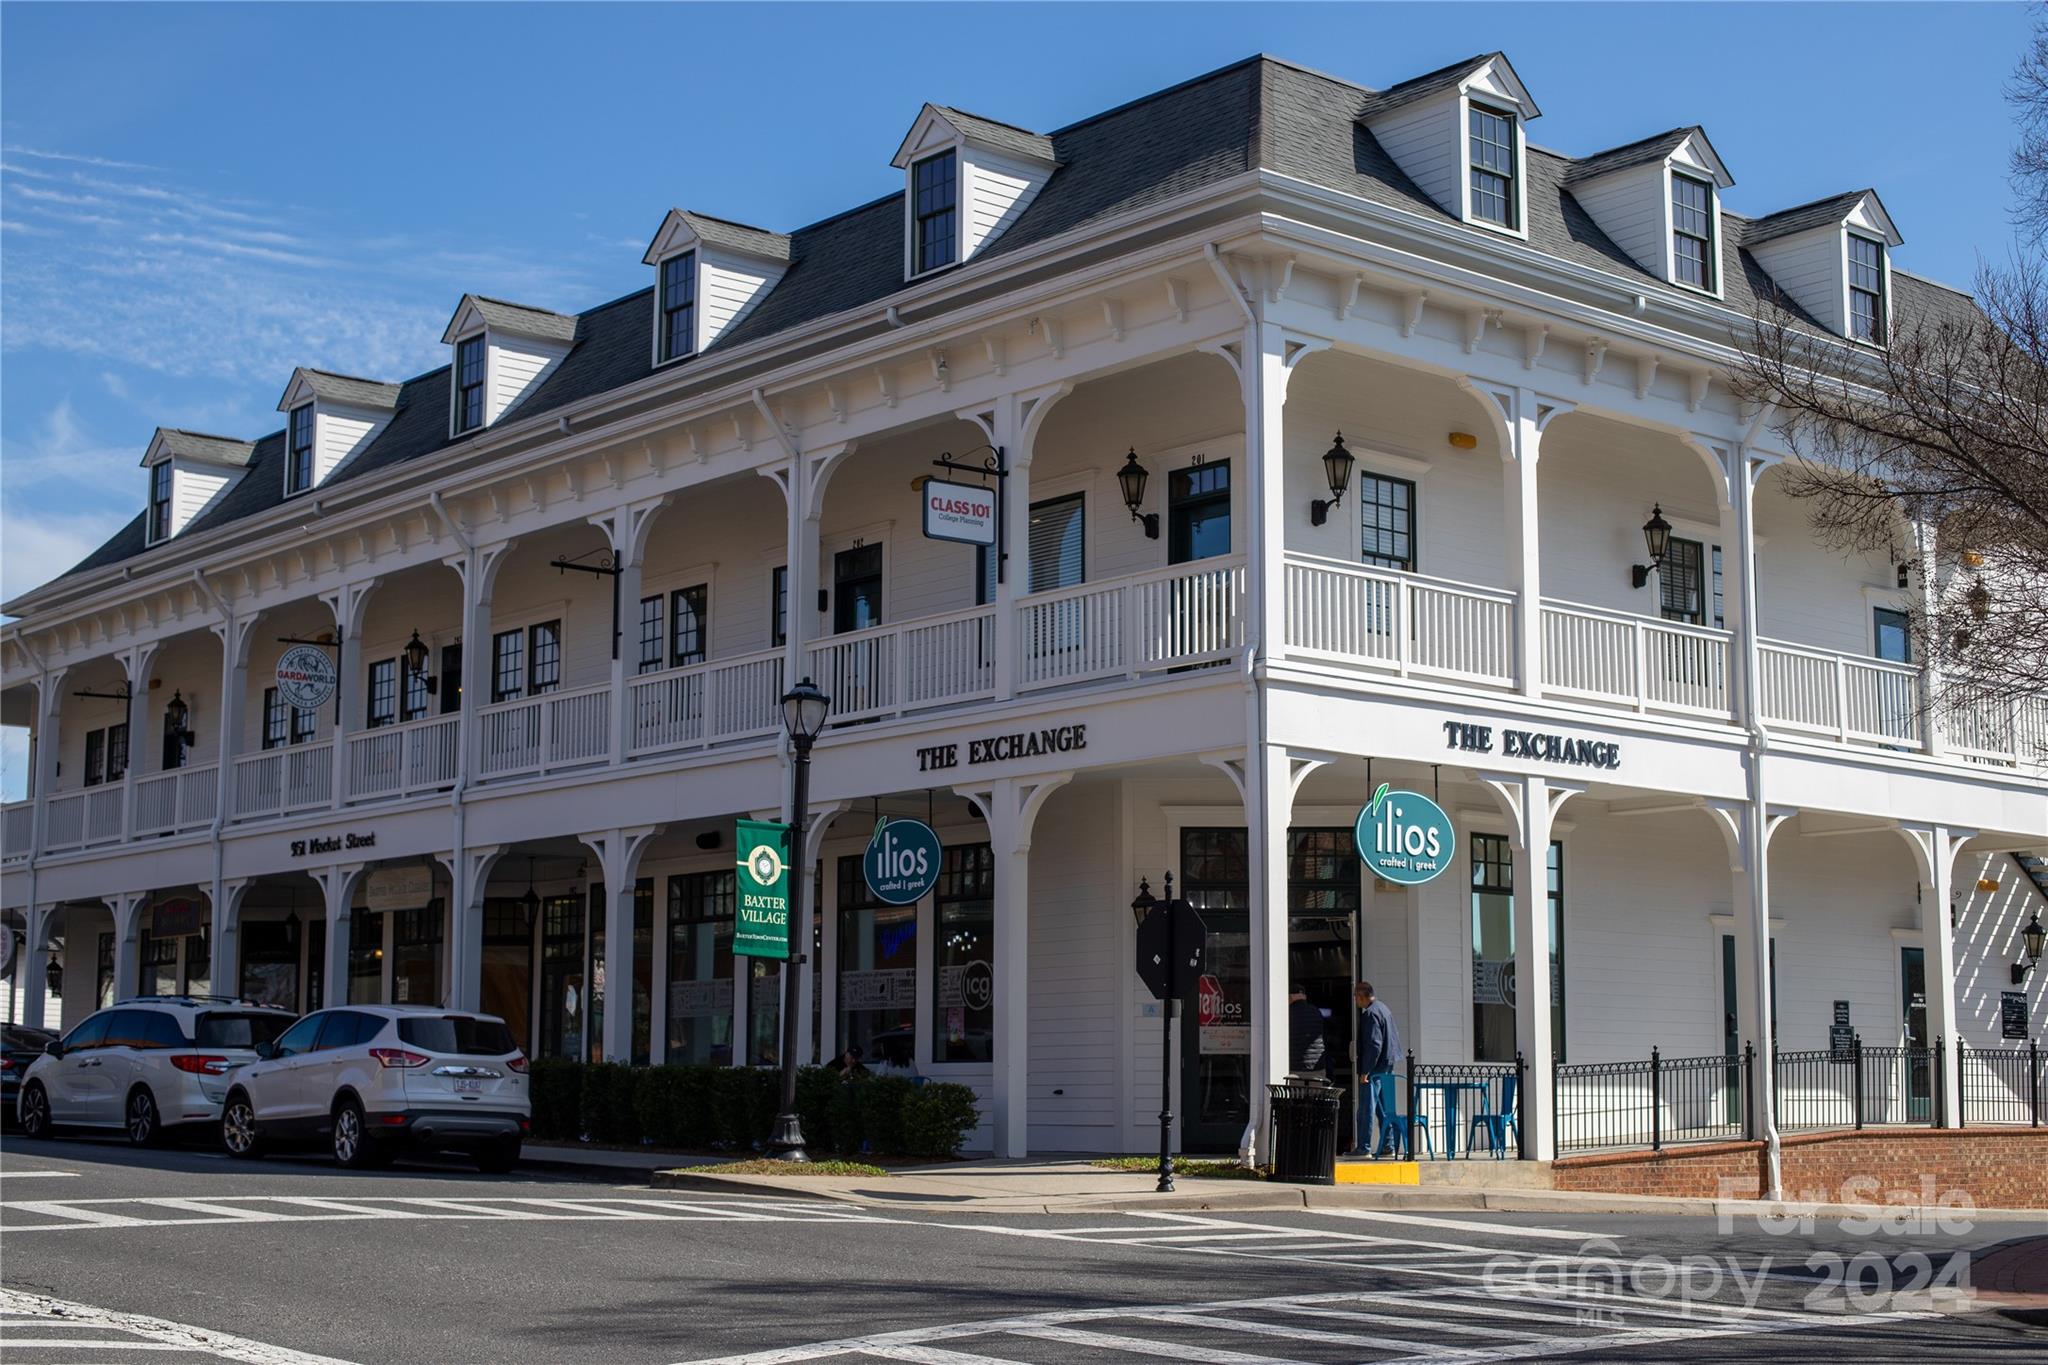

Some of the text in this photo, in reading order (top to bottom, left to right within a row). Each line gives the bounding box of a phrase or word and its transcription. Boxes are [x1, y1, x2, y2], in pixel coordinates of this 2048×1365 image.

[1192, 453, 1205, 465] 201
[931, 496, 990, 519] CLASS 101
[938, 513, 984, 527] College Planning
[277, 670, 336, 684] GARDAWORLD
[916, 724, 1087, 771] THE EXCHANGE
[1443, 720, 1621, 770] THE EXCHANGE
[1376, 800, 1440, 857] ilios
[290, 831, 375, 857] 951 Market Street
[877, 831, 928, 879] ilios
[1379, 856, 1437, 872] crafted greek
[880, 877, 925, 891] crafted greek
[744, 894, 786, 910] BAXTER
[741, 909, 787, 925] VILLAGE
[966, 977, 991, 1001] icg
